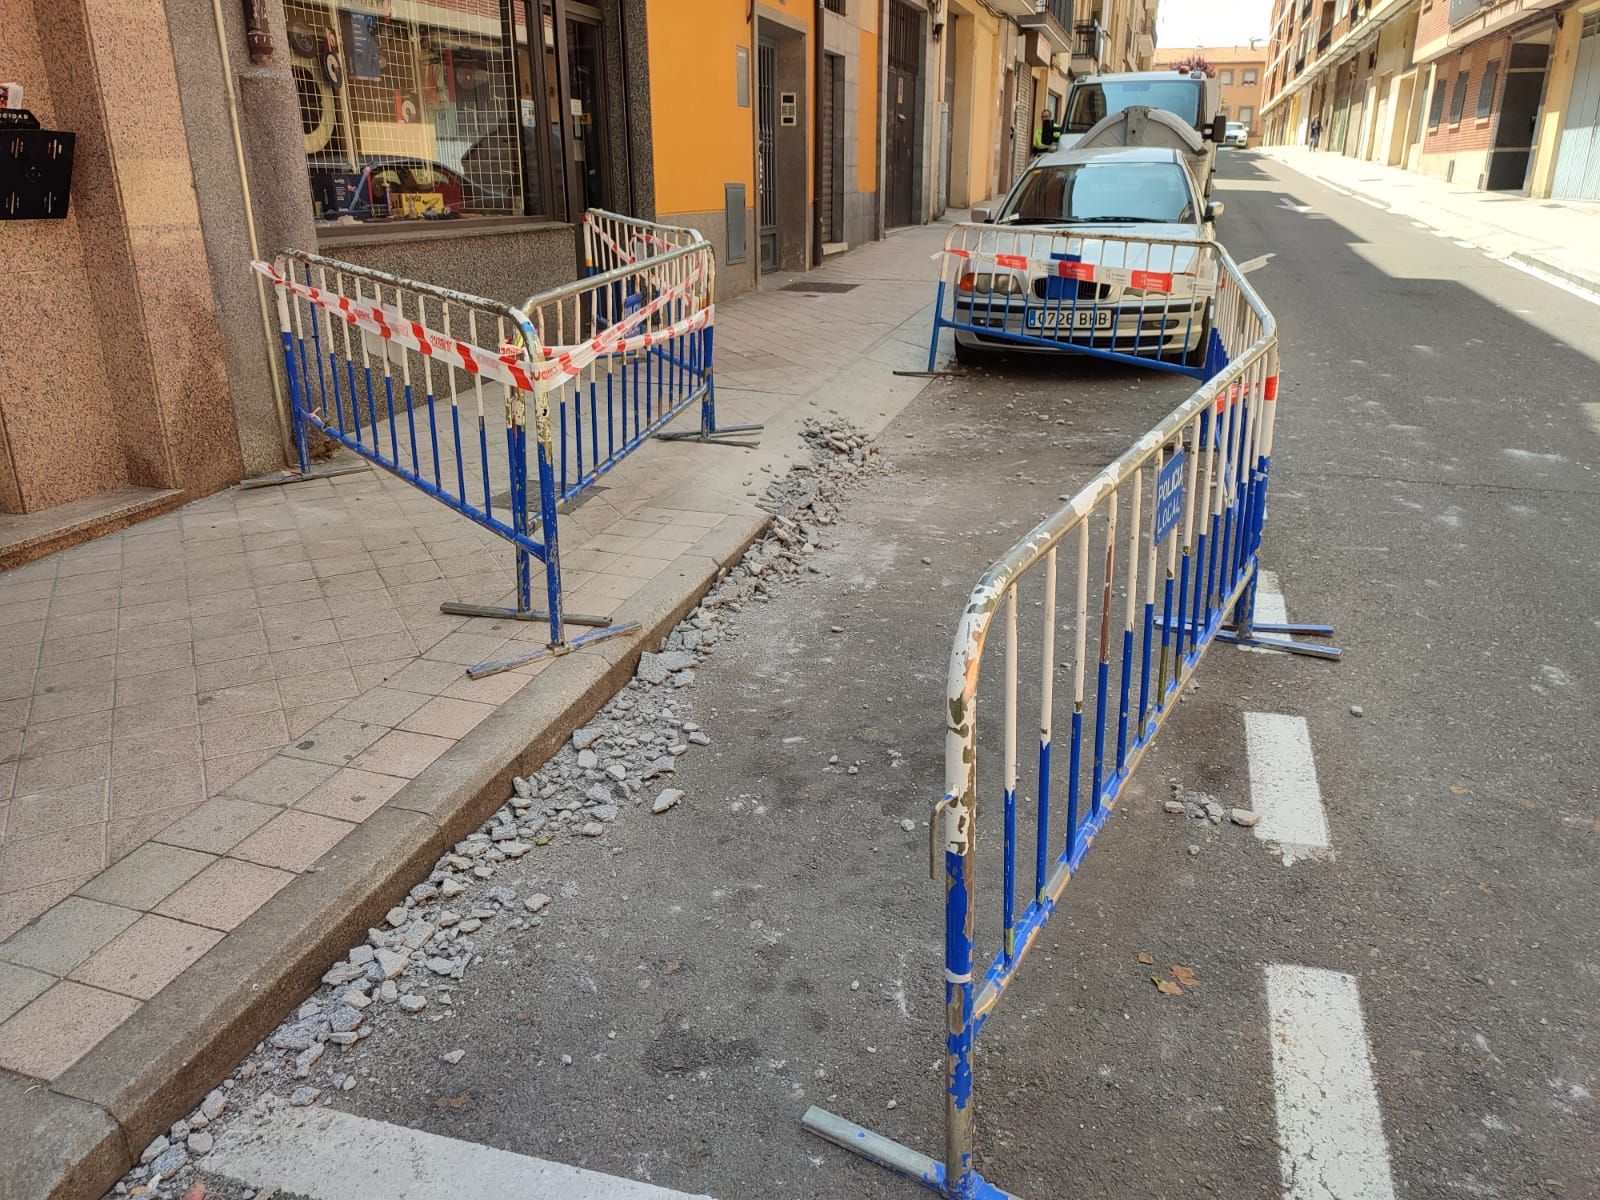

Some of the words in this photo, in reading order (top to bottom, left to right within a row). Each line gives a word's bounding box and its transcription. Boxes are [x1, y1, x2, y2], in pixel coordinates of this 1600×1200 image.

[1038, 312, 1073, 326] 0726
[1079, 312, 1107, 326] BHB
[1157, 495, 1181, 535] LOCAL
